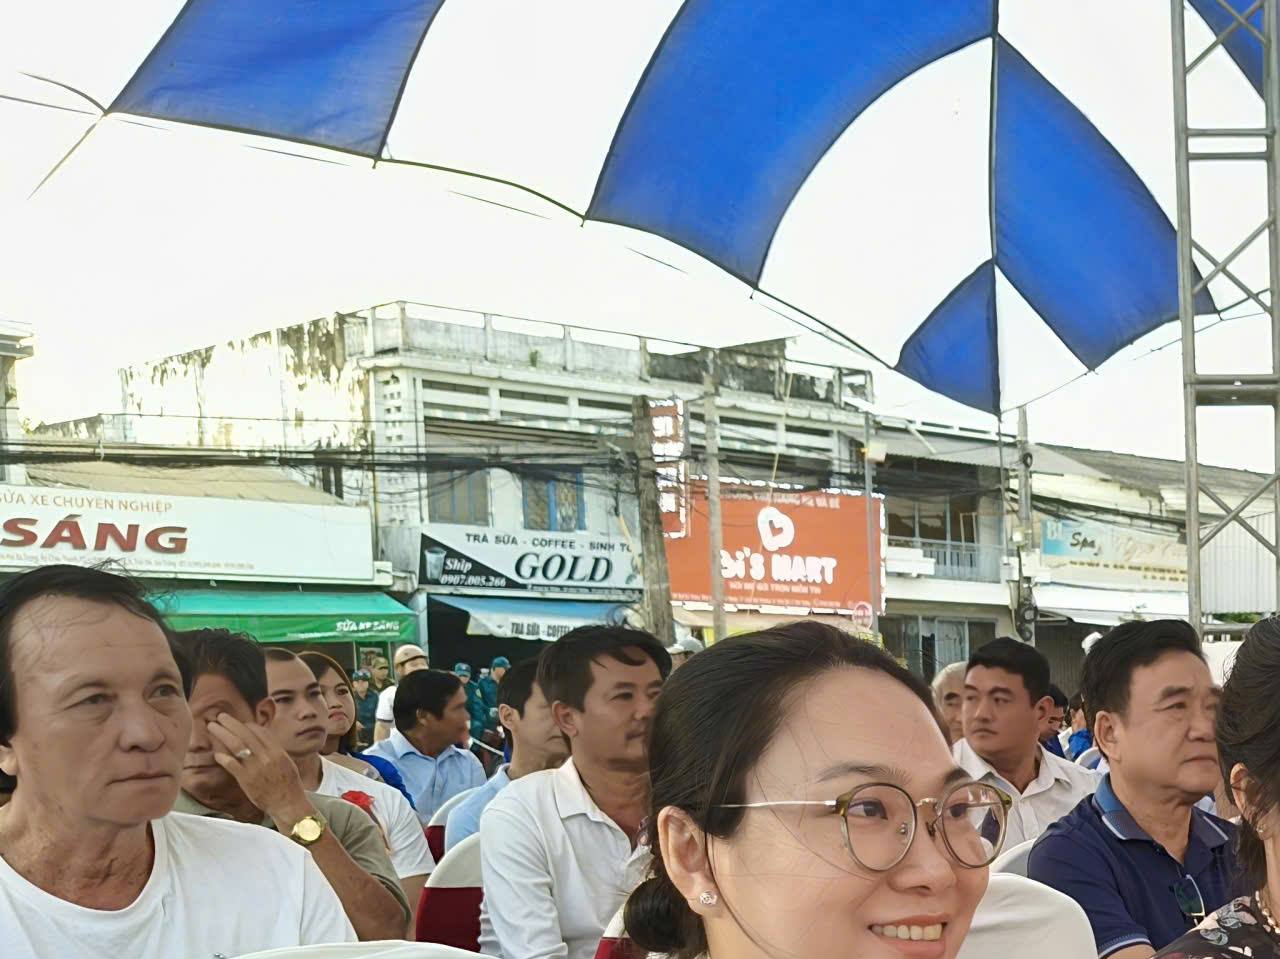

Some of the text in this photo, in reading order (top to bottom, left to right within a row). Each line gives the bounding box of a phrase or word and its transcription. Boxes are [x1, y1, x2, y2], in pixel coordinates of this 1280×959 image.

[31, 493, 49, 506] XE
[0, 513, 188, 554] SÁNG
[1070, 531, 1097, 551] Spa
[531, 537, 576, 550] COFFEE
[589, 541, 615, 551] SINH
[444, 557, 473, 574] Ship
[514, 551, 613, 583] GOLD
[771, 553, 837, 584] MART
